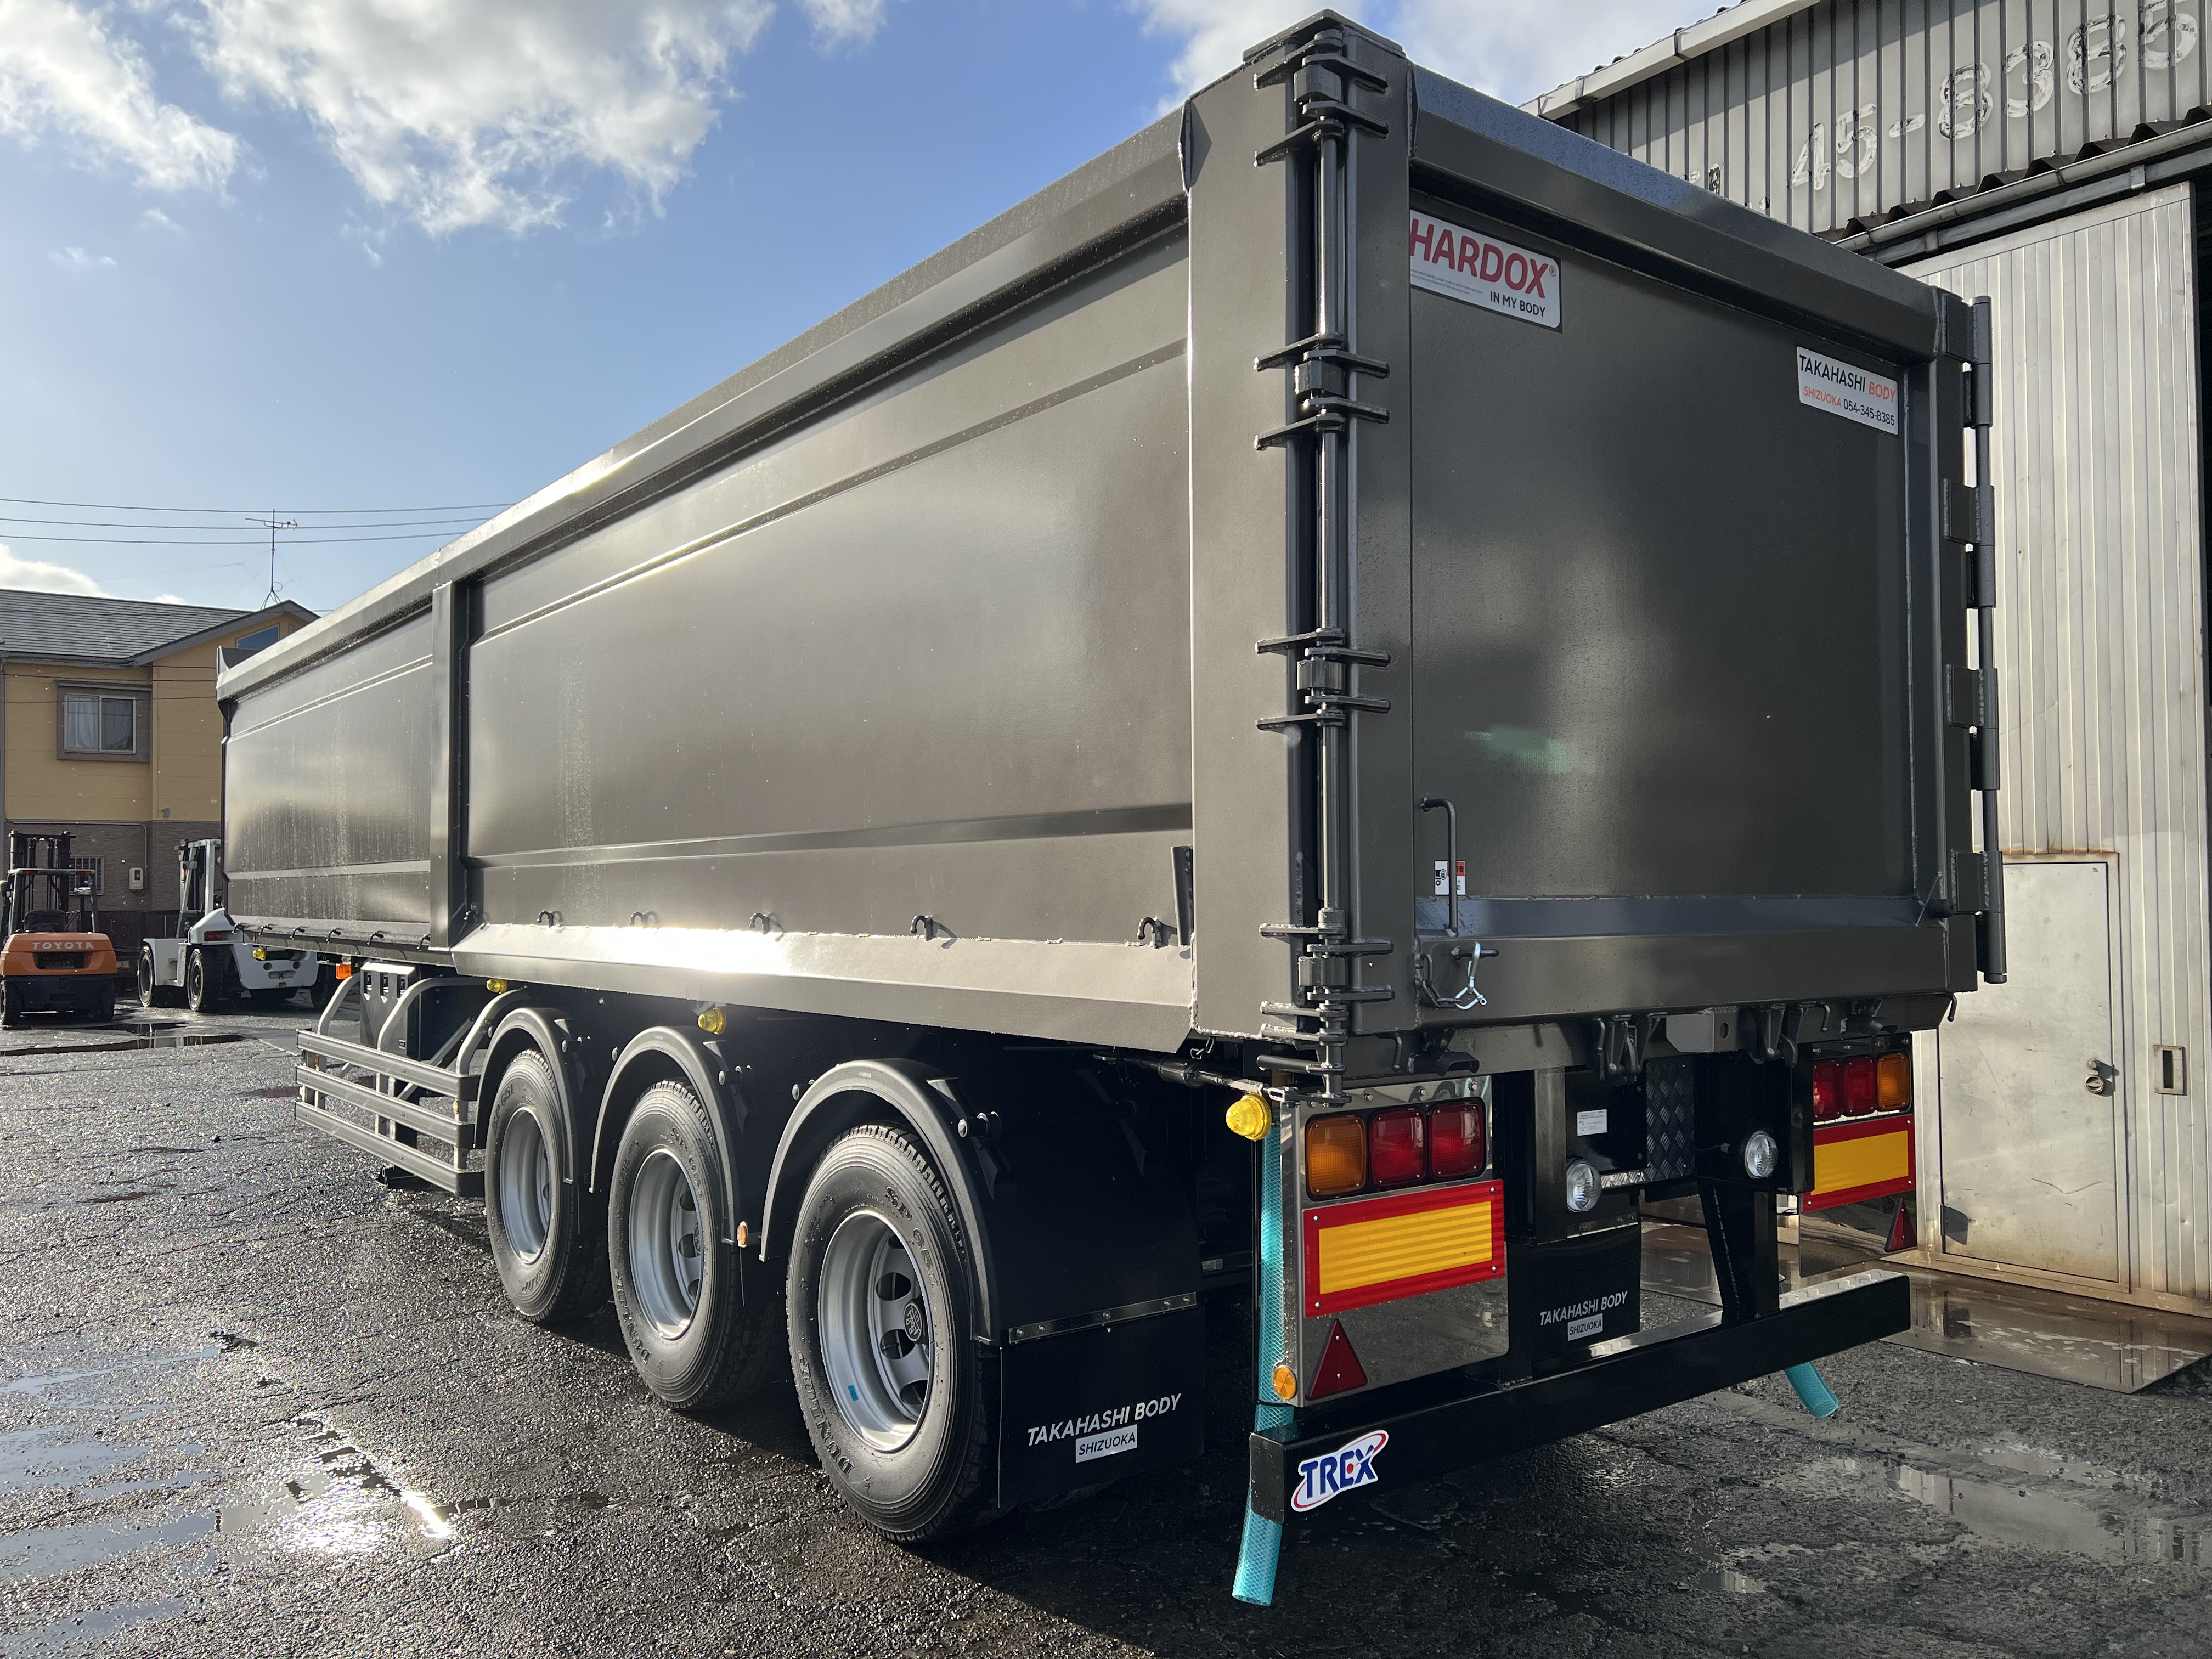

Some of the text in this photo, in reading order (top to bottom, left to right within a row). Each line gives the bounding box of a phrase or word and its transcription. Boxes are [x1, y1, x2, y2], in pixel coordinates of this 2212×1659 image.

[1490, 290, 1545, 317] IN MY BODY
[1799, 354, 1897, 403] TAKAHASHI BODY
[1803, 386, 1895, 426] SHIZUOKA 054-345-8385
[32, 941, 94, 950] TOYOTA
[1540, 1290, 1628, 1326] TAKAHASHI BODY
[1569, 1319, 1602, 1335] SHIZUOKA
[1028, 1392, 1182, 1446] TAKAHASHI BODY
[1078, 1432, 1135, 1456] SHIZUOKA
[1300, 1444, 1376, 1499] TREX
